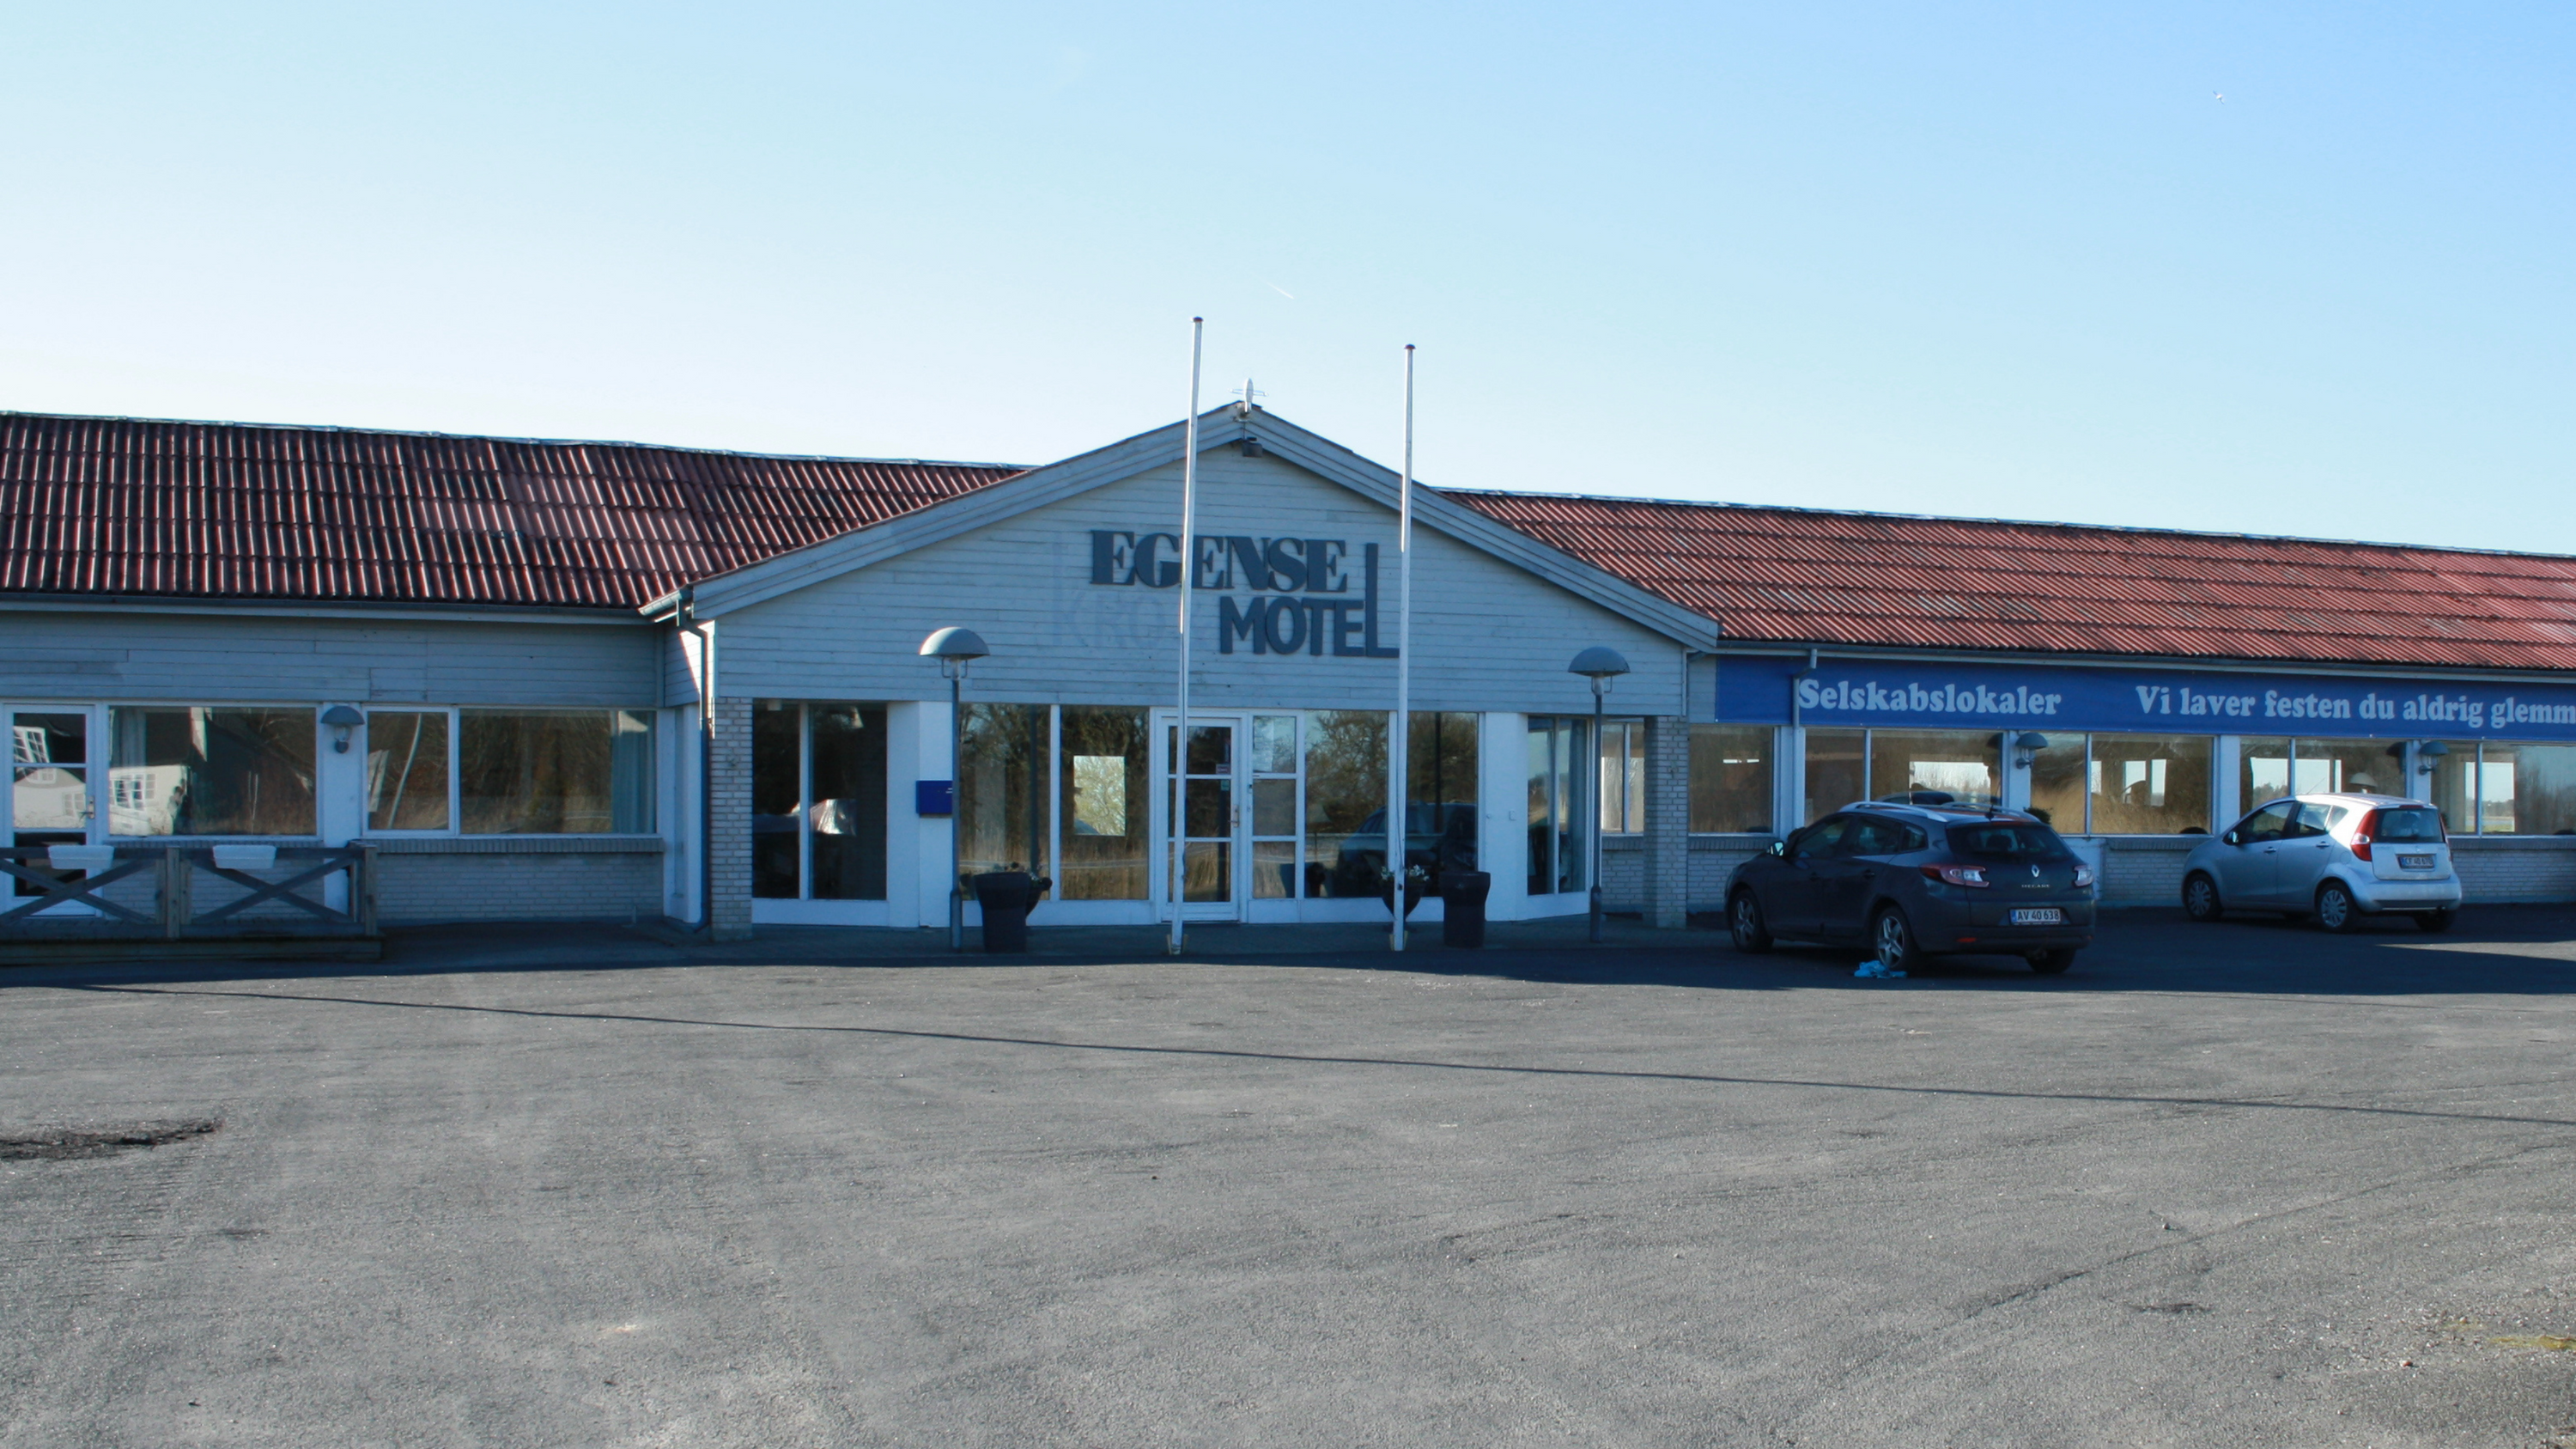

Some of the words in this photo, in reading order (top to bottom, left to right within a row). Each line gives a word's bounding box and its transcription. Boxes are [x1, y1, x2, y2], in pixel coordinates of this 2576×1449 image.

[1089, 529, 1347, 593] EGENSE
[1219, 543, 1400, 659] MOTEL
[1797, 679, 2062, 715] Selskabslokaler
[2136, 685, 2172, 715] Vi
[2179, 687, 2256, 716] laver
[2264, 690, 2351, 719] festen
[2359, 692, 2395, 720] du
[2403, 694, 2483, 728] aldrig
[2018, 910, 2029, 920] AV
[2032, 910, 2042, 920] 40
[2044, 910, 2059, 920] 638
